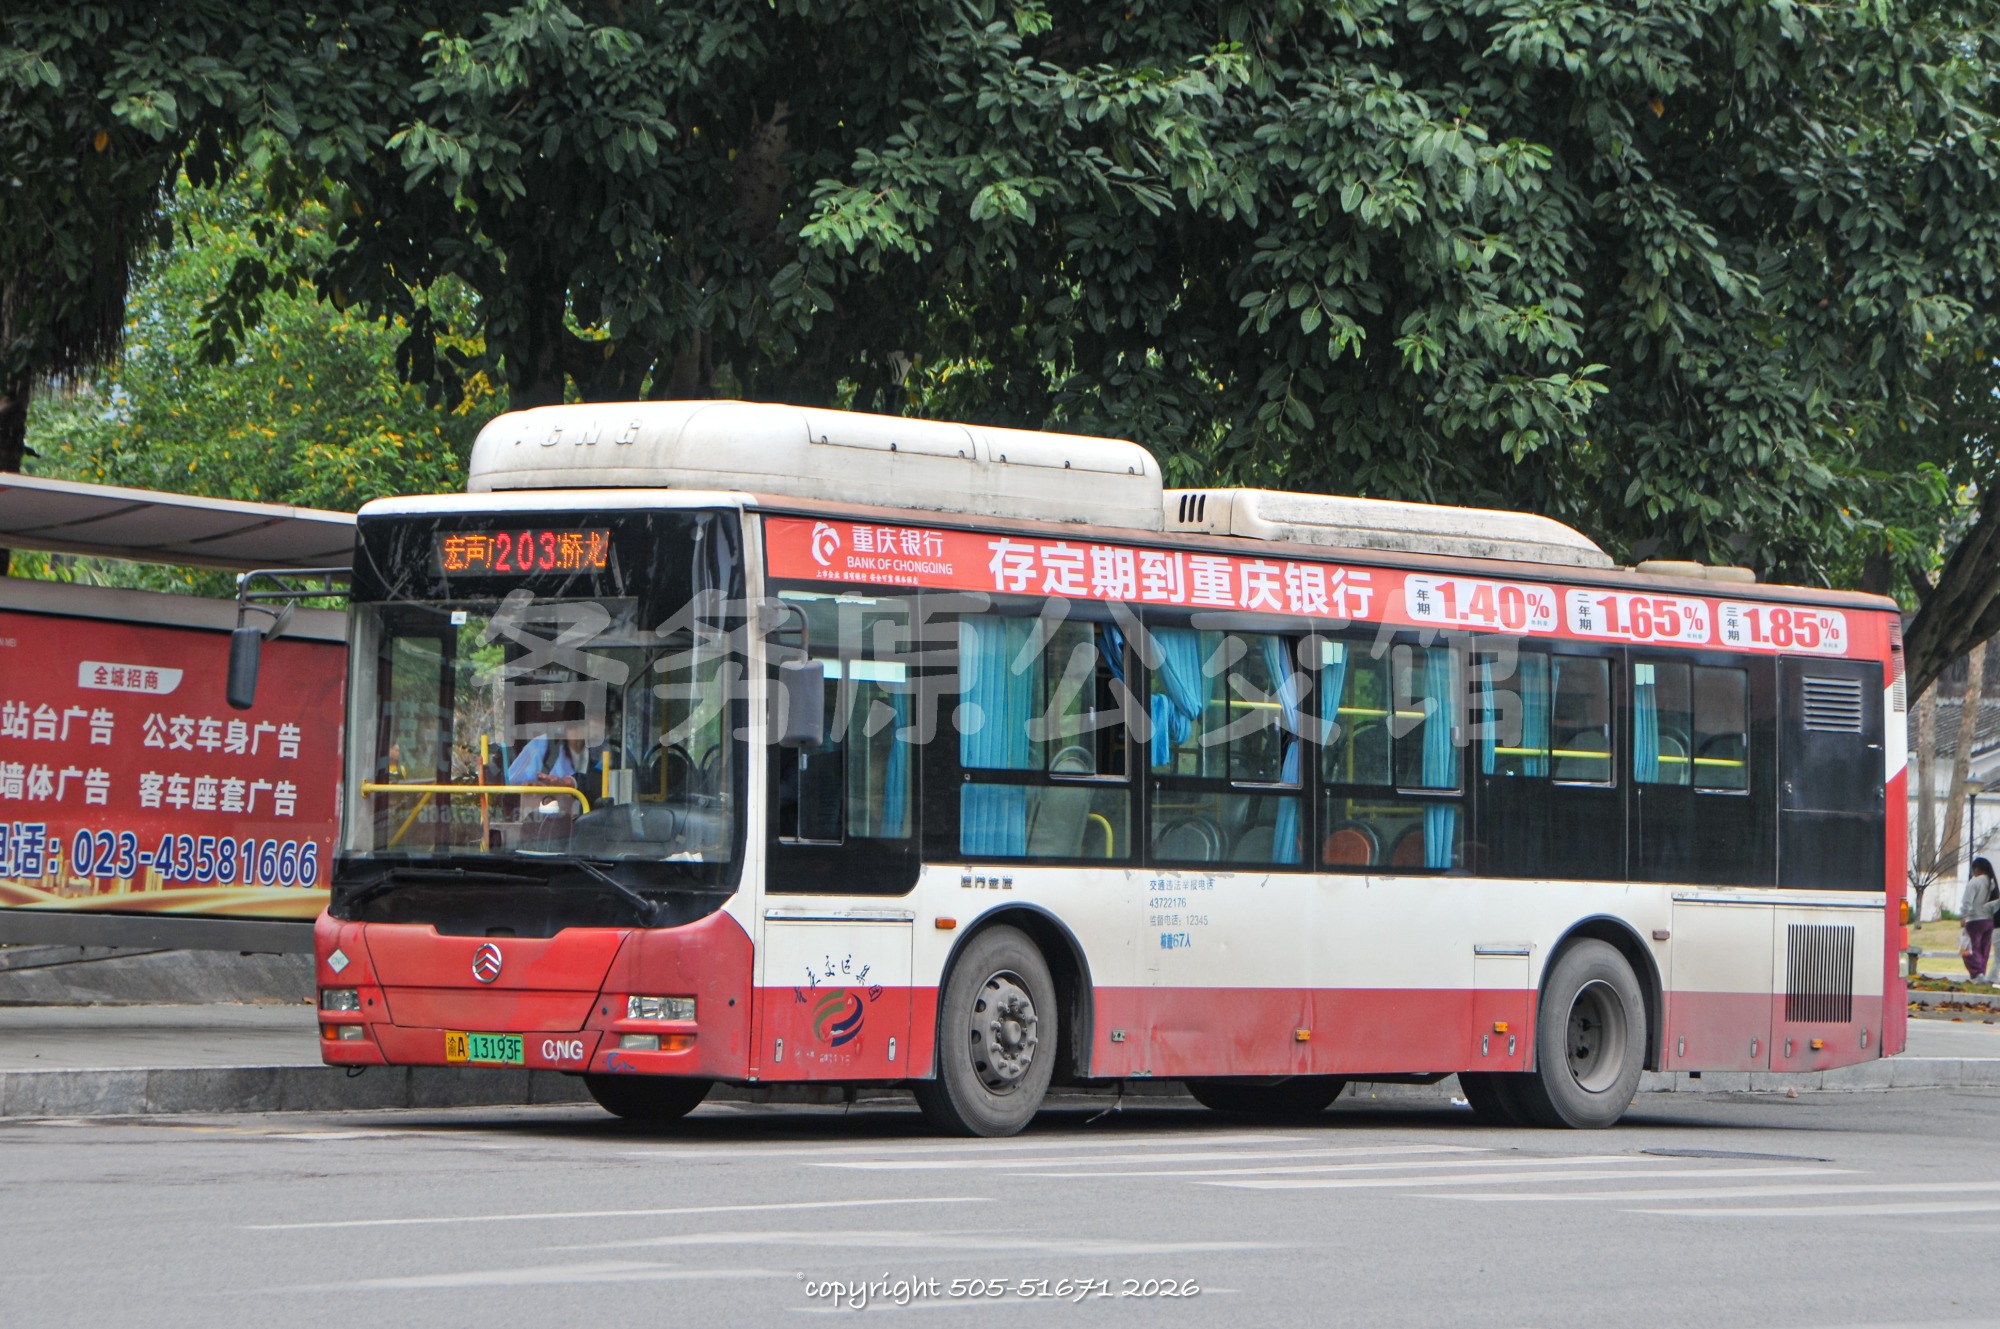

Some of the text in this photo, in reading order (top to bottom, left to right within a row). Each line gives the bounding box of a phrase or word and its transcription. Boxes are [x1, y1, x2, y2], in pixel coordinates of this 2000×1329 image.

[495, 532, 556, 571] 203
[851, 526, 944, 558] 重庆银行
[847, 556, 953, 575] BANK OF CHONGQING
[988, 537, 1374, 619] 存定期到重庆银行
[1415, 579, 1430, 615] 一年期
[1435, 581, 1550, 629] 1.40%
[1577, 593, 1592, 631] 二年期
[1596, 596, 1704, 639] 1.65%
[1726, 606, 1740, 641] 三年期
[1743, 608, 1839, 648] 1.85%
[94, 664, 159, 690] 全城招商
[1, 700, 115, 745] 站台广告
[142, 712, 302, 759] 公交车身广告
[0, 761, 111, 805] 墙体广告
[139, 771, 298, 817] 客车座套广告
[1149, 897, 1187, 909] 43722176
[473, 1037, 521, 1061] 13193F
[542, 1039, 584, 1060] CNG
